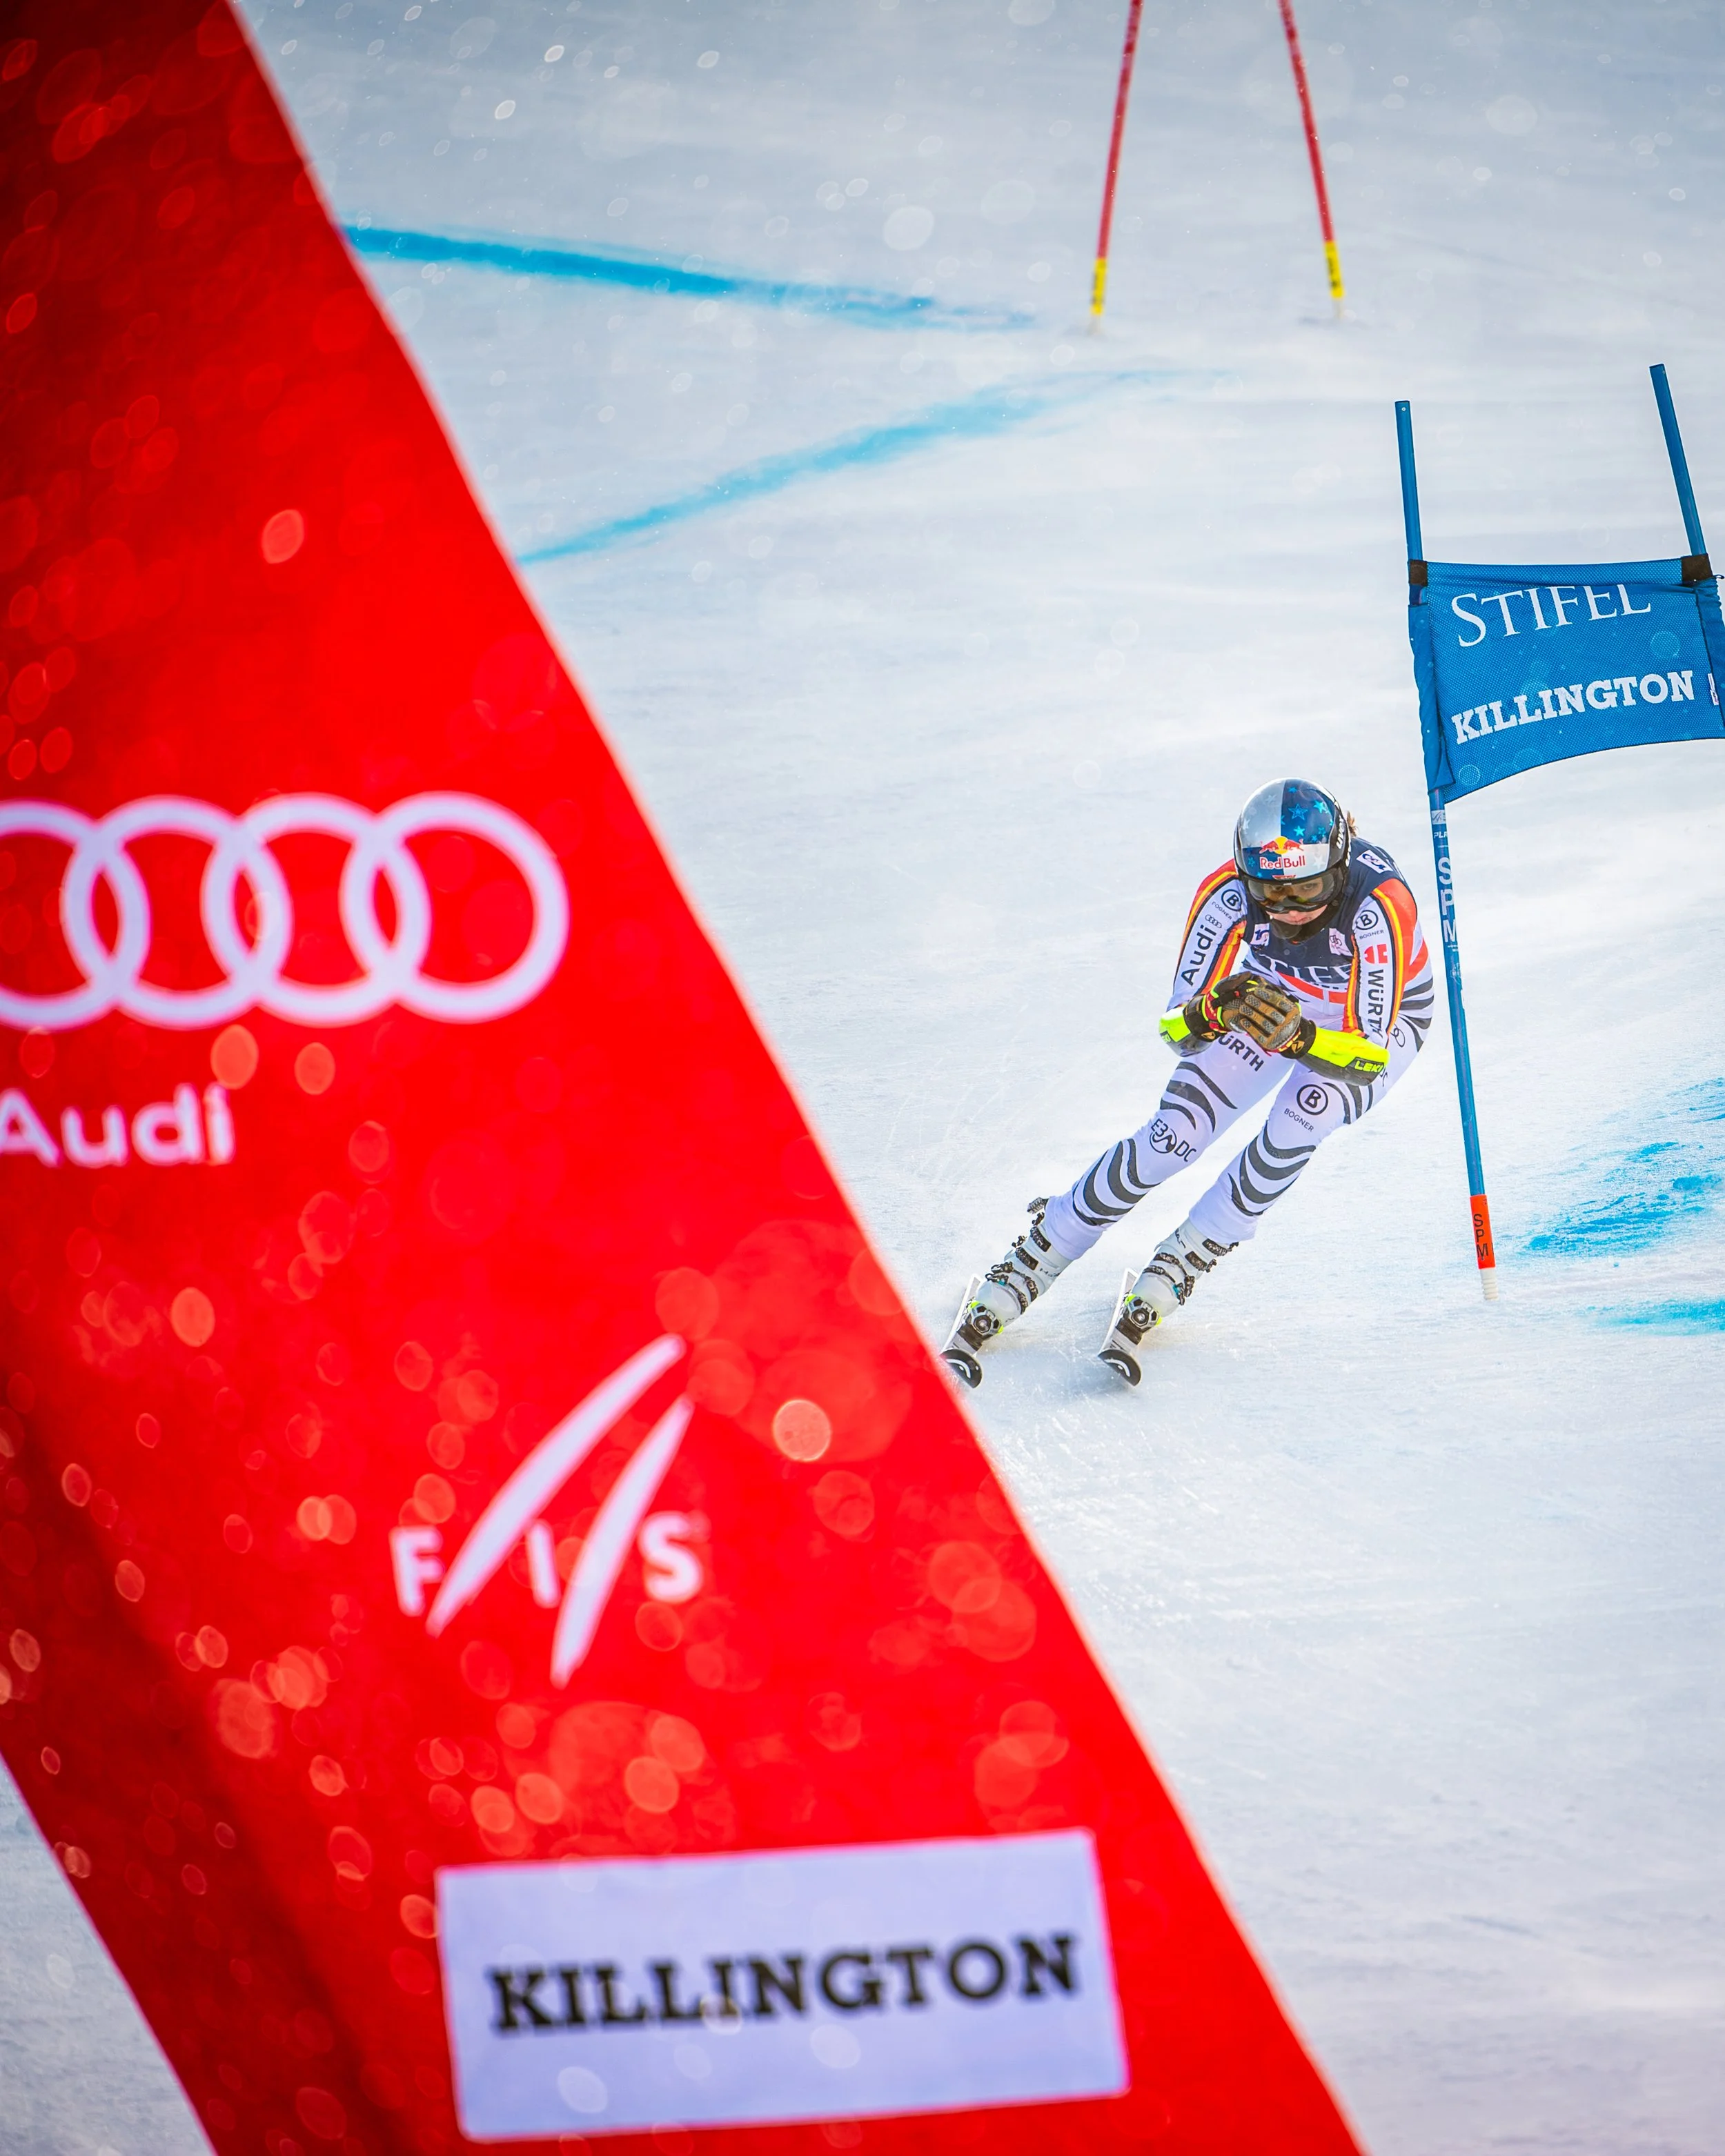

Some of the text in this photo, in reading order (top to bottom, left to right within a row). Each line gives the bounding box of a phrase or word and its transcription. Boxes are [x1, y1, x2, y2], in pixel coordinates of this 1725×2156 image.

[1451, 584, 1651, 647] STIFEL
[1452, 671, 1695, 744] KILLINGTON
[1260, 856, 1305, 869] Red Bull
[1181, 924, 1216, 987] Audi
[1359, 929, 1384, 939] BOGNER
[1219, 1036, 1265, 1072] ÜRTH
[1354, 1060, 1383, 1072] LEKI
[0, 1083, 236, 1167] Audi
[1284, 1108, 1314, 1132] BOGNER
[489, 1935, 1078, 2033] KILLINGTON
